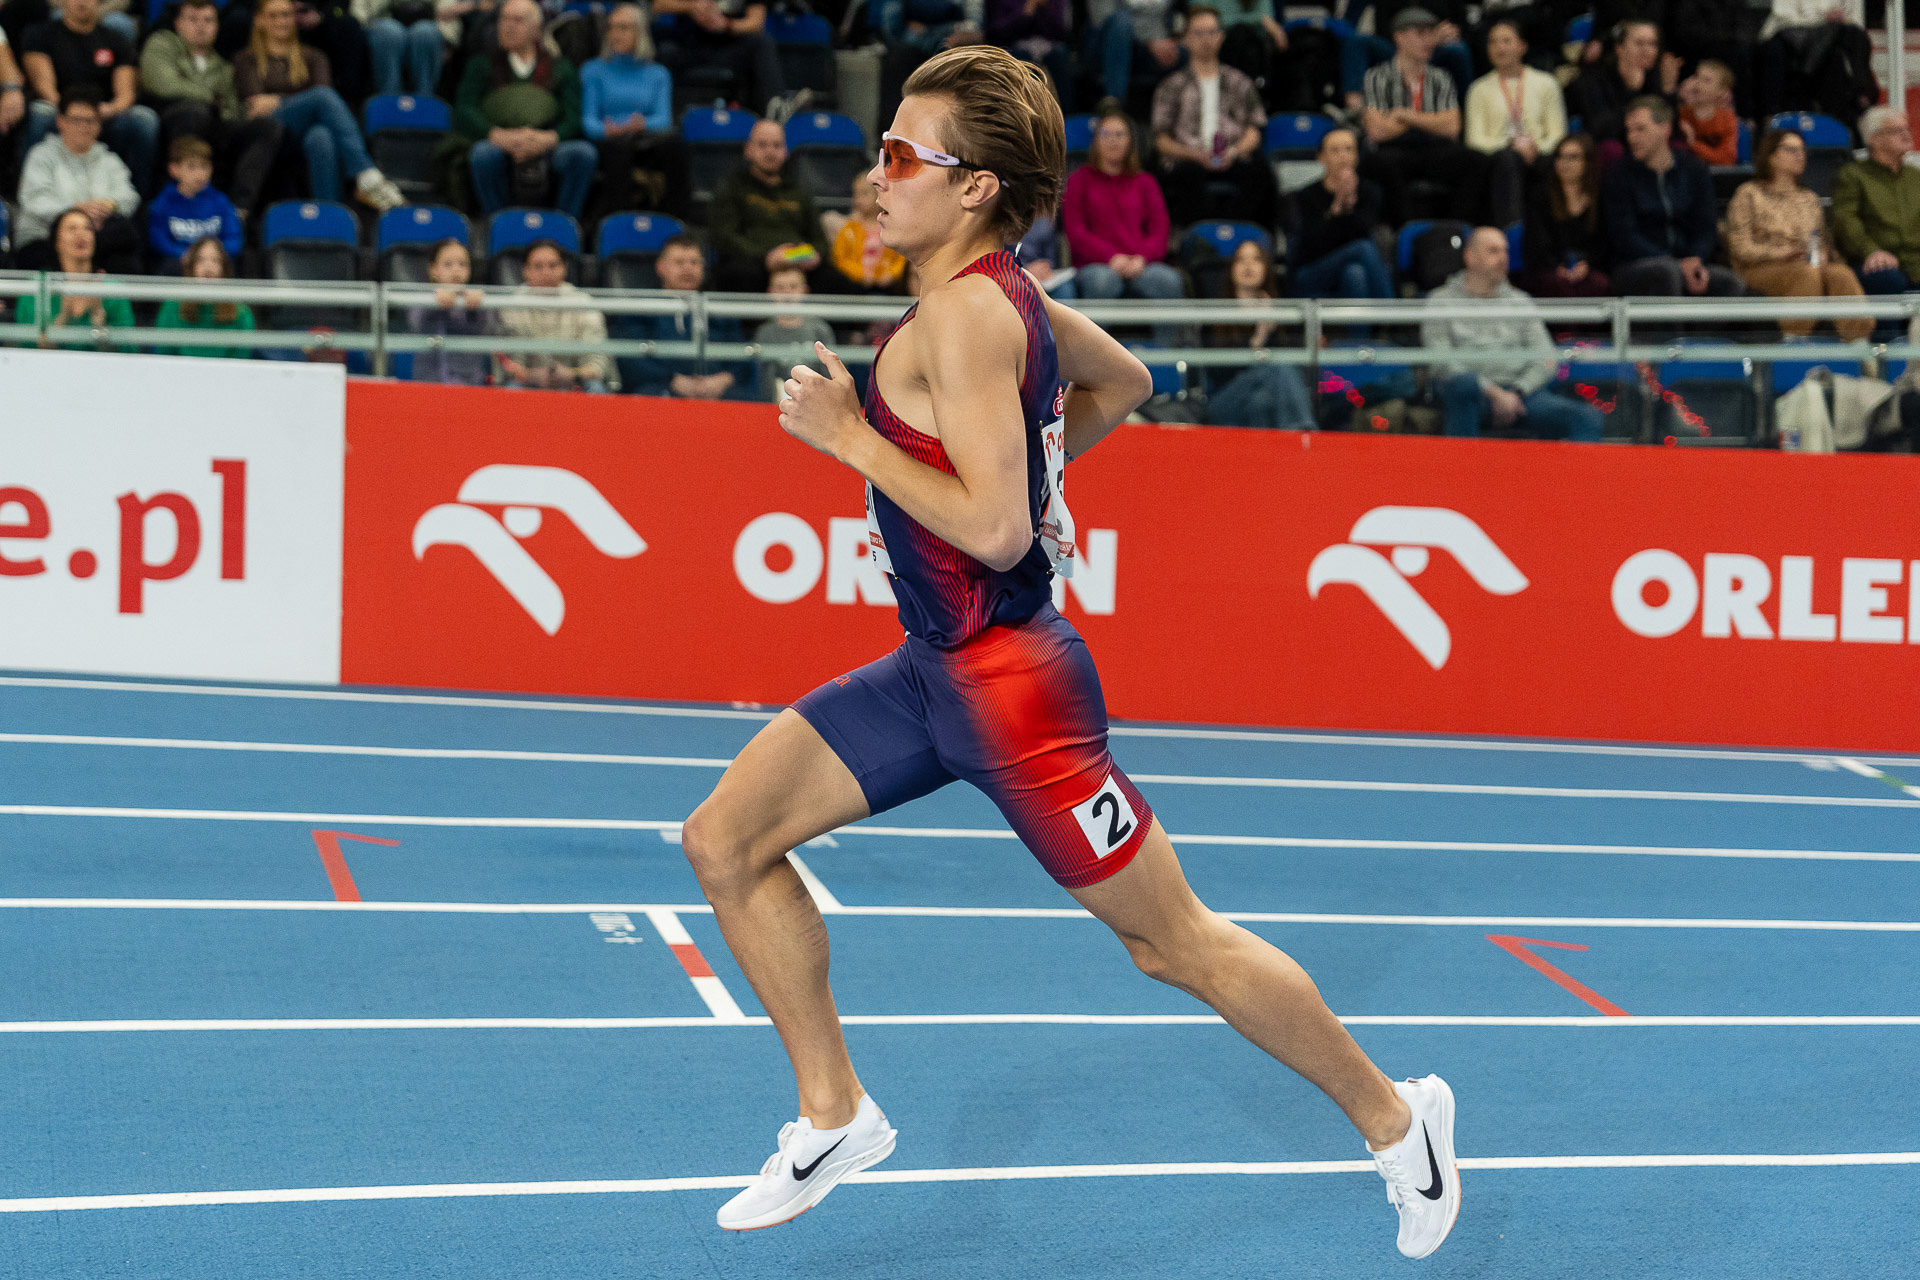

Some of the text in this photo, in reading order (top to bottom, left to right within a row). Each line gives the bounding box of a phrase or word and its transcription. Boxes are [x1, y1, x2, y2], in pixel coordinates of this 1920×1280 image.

[733, 512, 1118, 615] ORN
[1611, 548, 1920, 645] ORLE
[1092, 791, 1132, 848] 2
